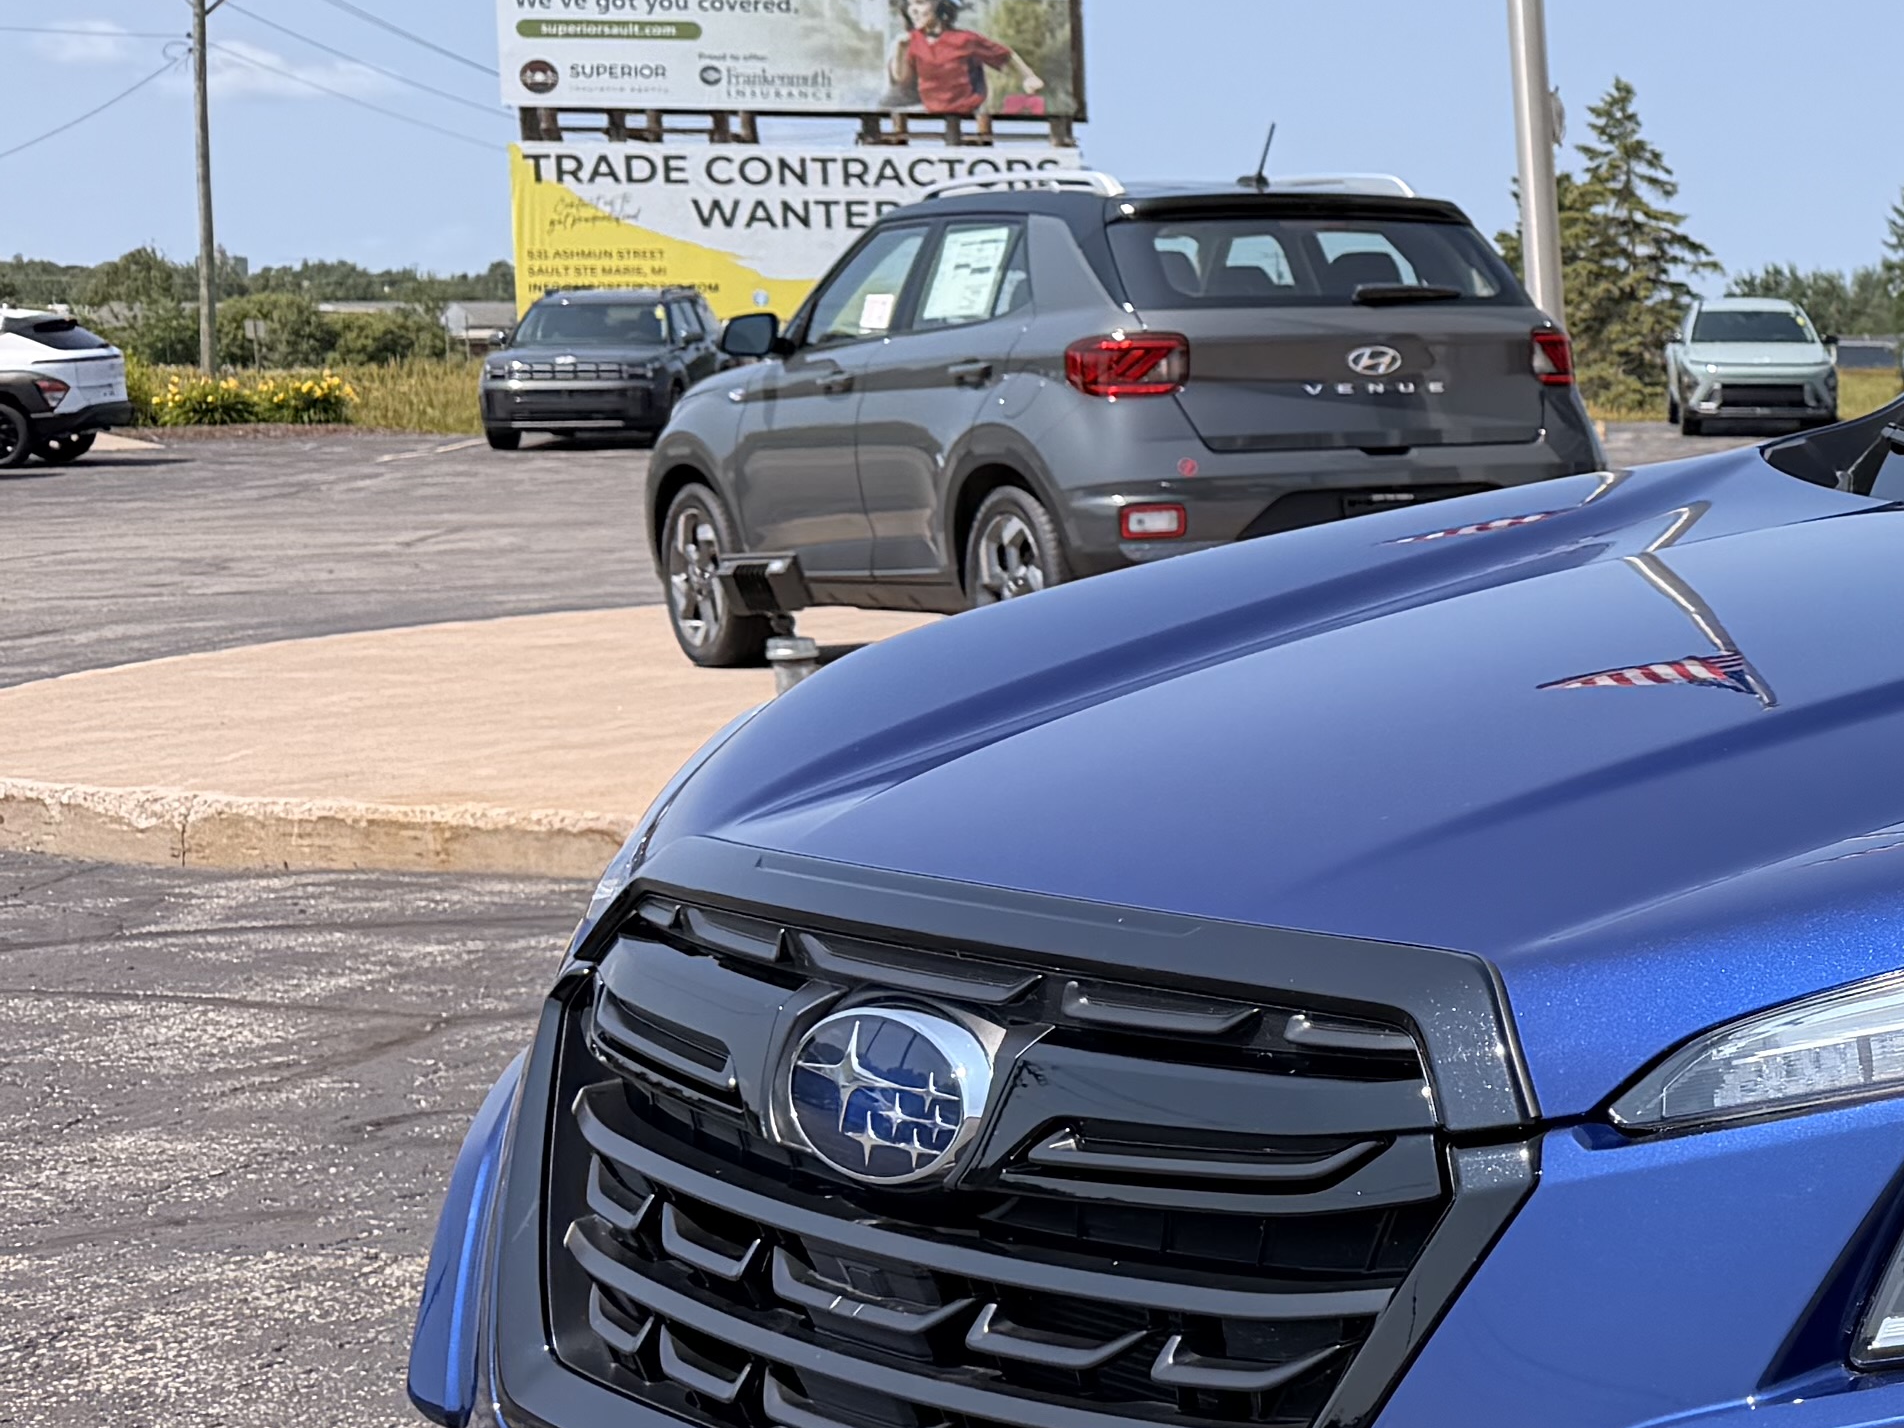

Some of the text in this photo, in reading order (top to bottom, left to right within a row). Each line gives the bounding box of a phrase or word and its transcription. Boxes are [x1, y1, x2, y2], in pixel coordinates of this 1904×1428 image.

[569, 63, 667, 80] SUPERIOR
[521, 153, 690, 185] TRADE
[616, 249, 665, 261] STREET
[527, 266, 570, 278] SAULT
[573, 266, 598, 278] STE
[1302, 380, 1446, 396] VENUE
